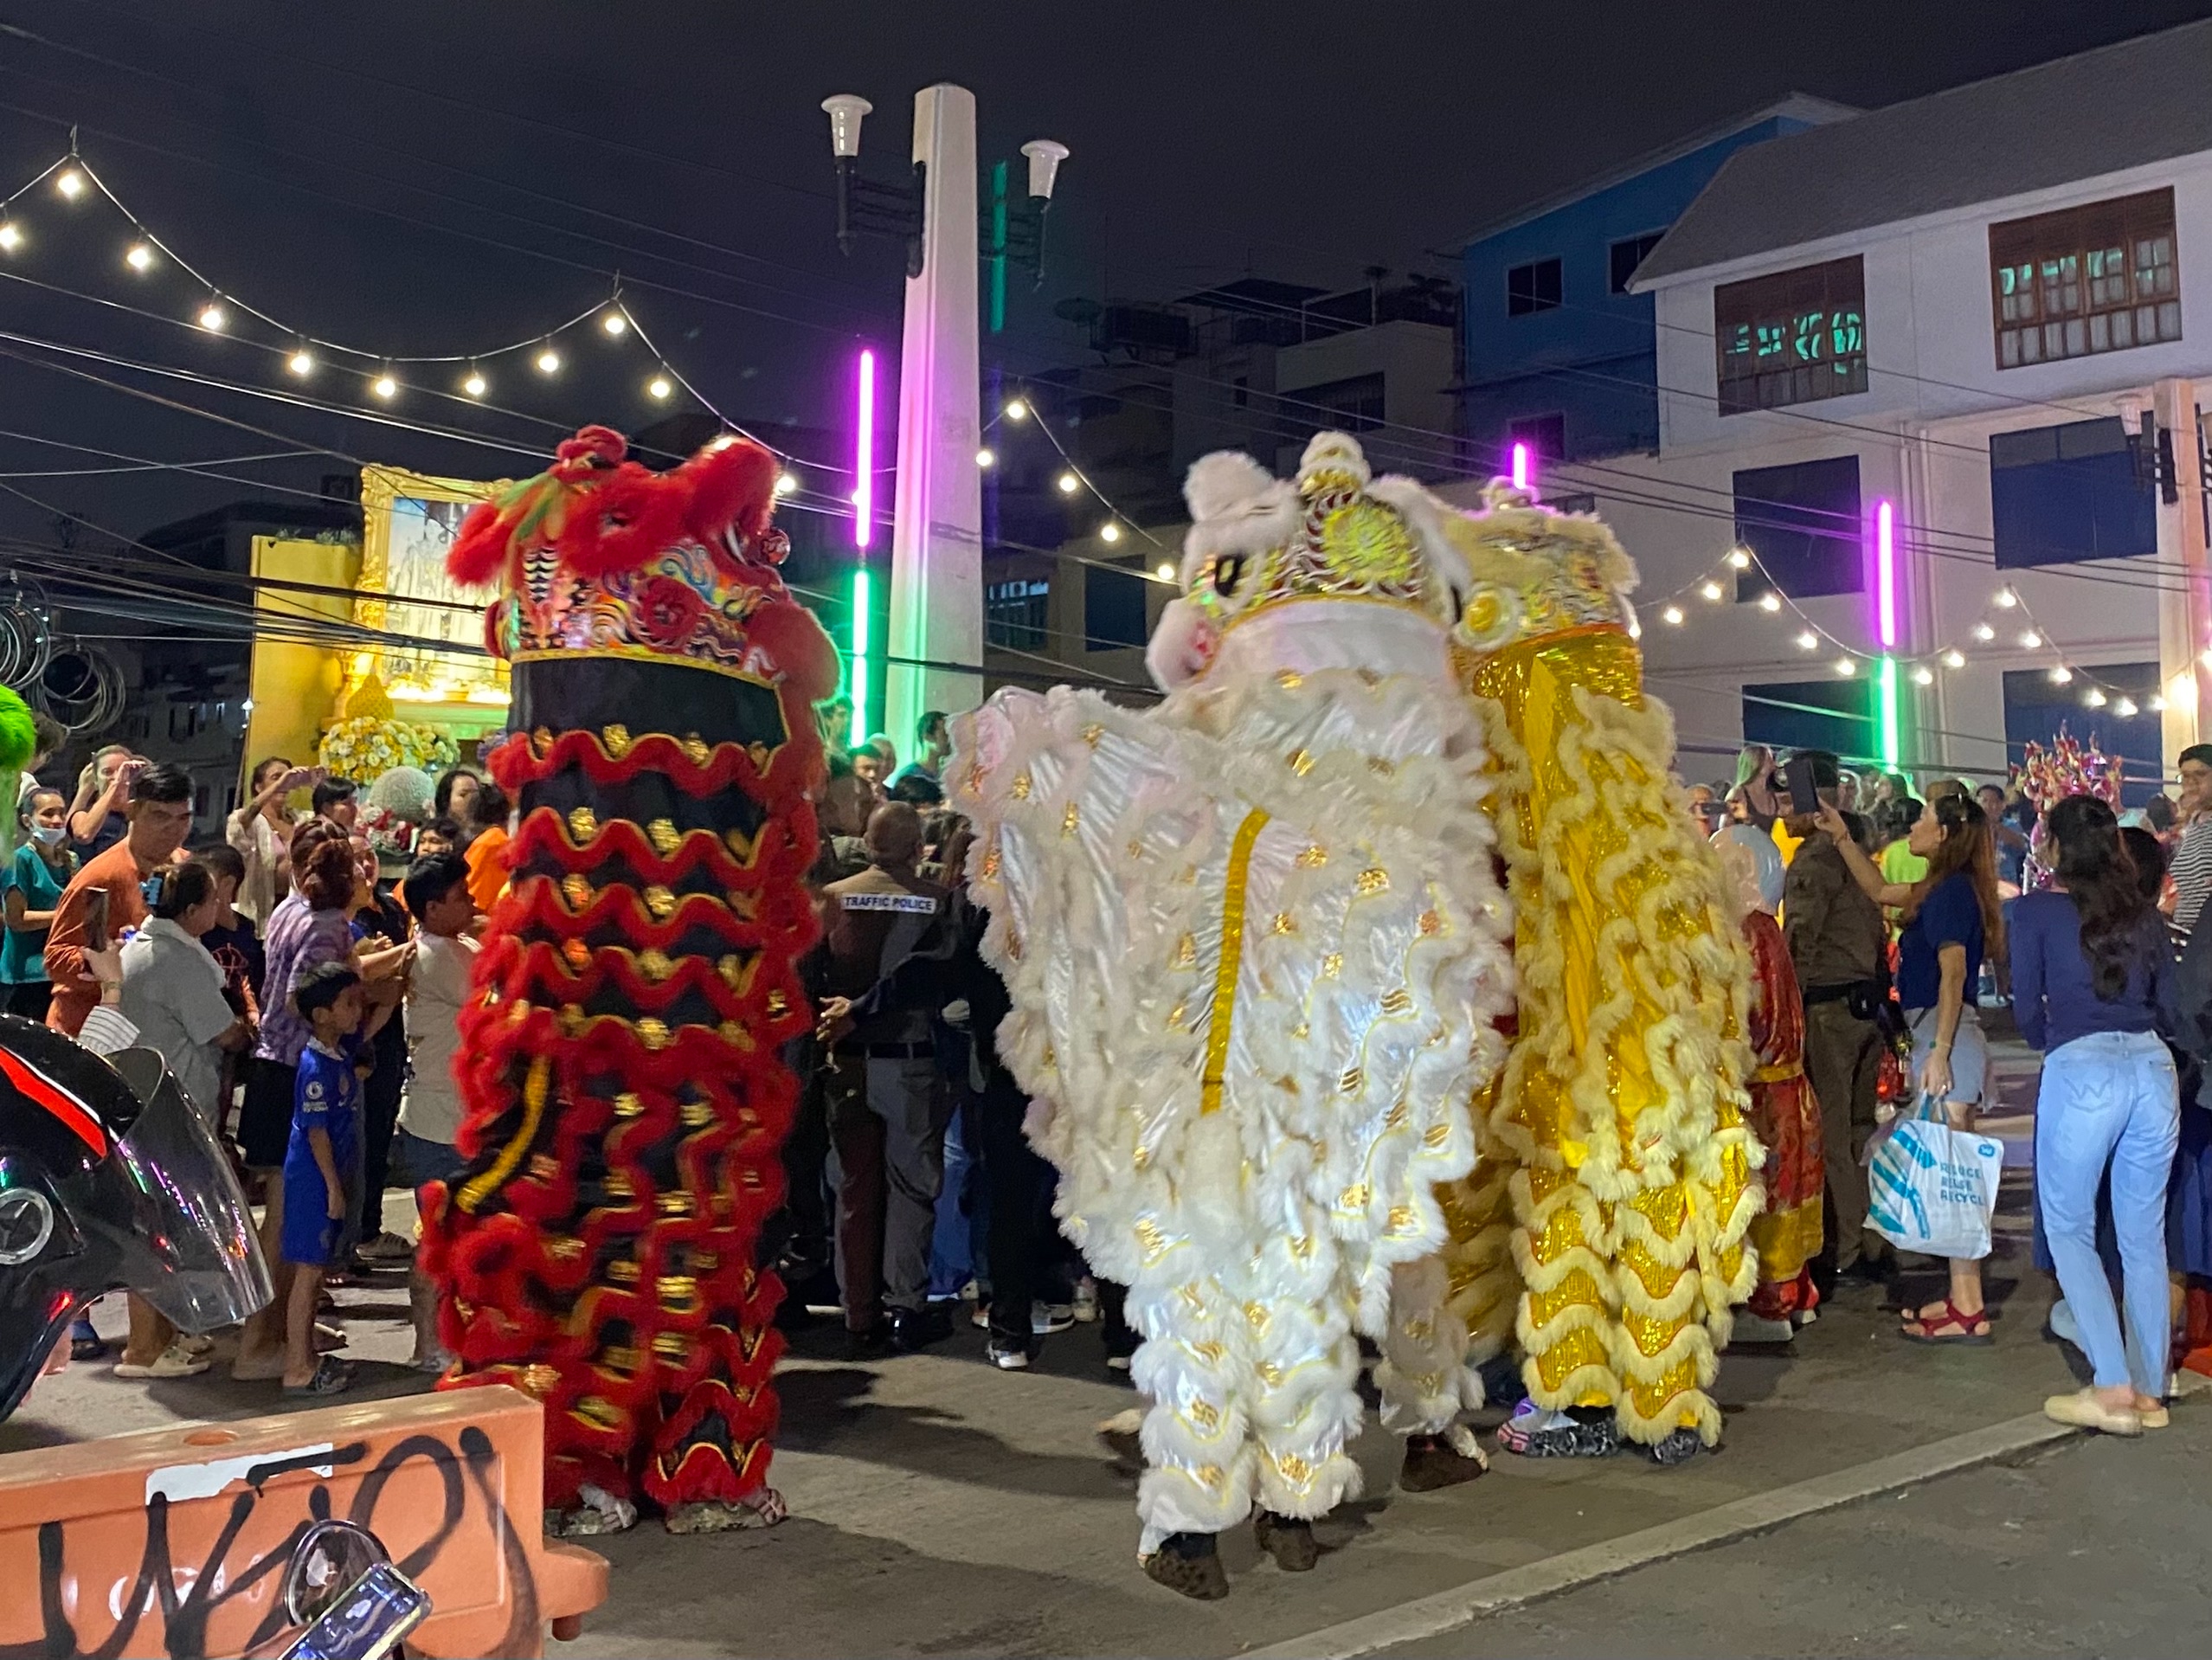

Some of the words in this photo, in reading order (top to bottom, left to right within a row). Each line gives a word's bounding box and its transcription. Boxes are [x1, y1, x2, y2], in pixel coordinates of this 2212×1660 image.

[845, 896, 890, 907] TRAFFIC
[891, 897, 933, 910] POLICE
[1940, 1189, 1985, 1206] RECYCL
